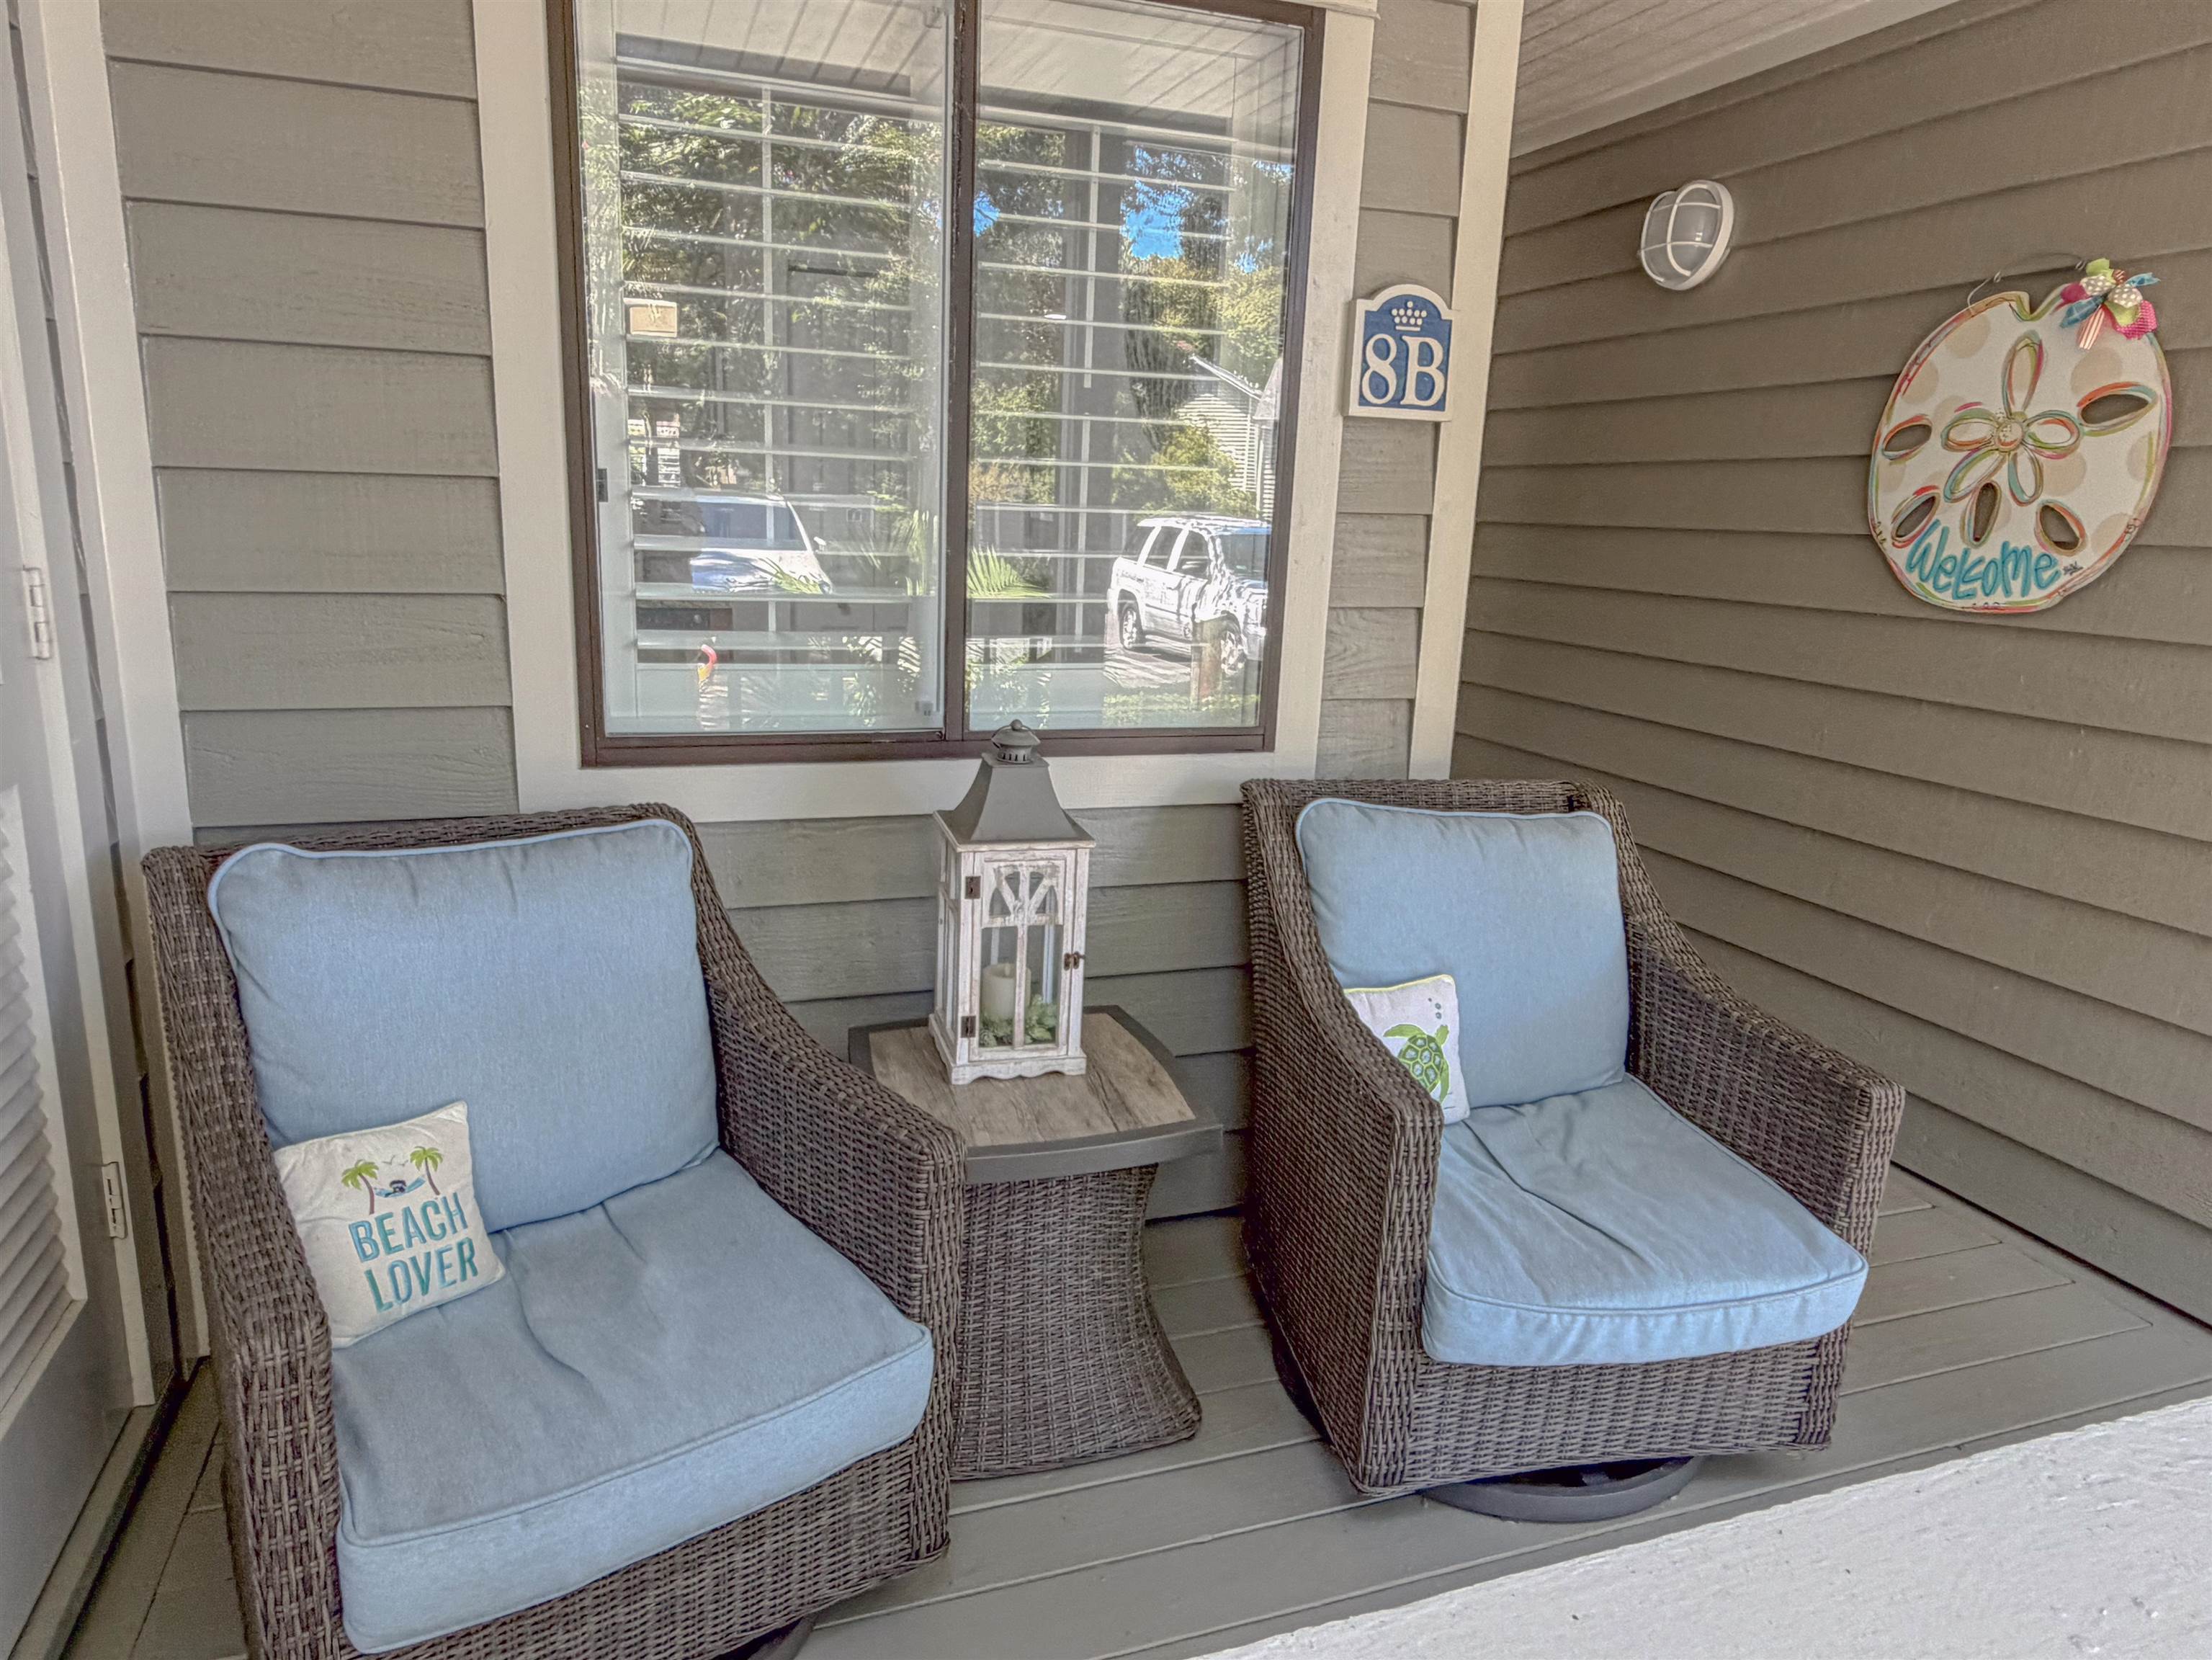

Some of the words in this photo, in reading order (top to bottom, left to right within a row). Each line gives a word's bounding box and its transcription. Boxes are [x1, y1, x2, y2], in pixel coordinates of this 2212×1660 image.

[1361, 334, 1445, 406] 8B
[349, 1192, 467, 1262] BEACH
[364, 1237, 478, 1312] LOVER
